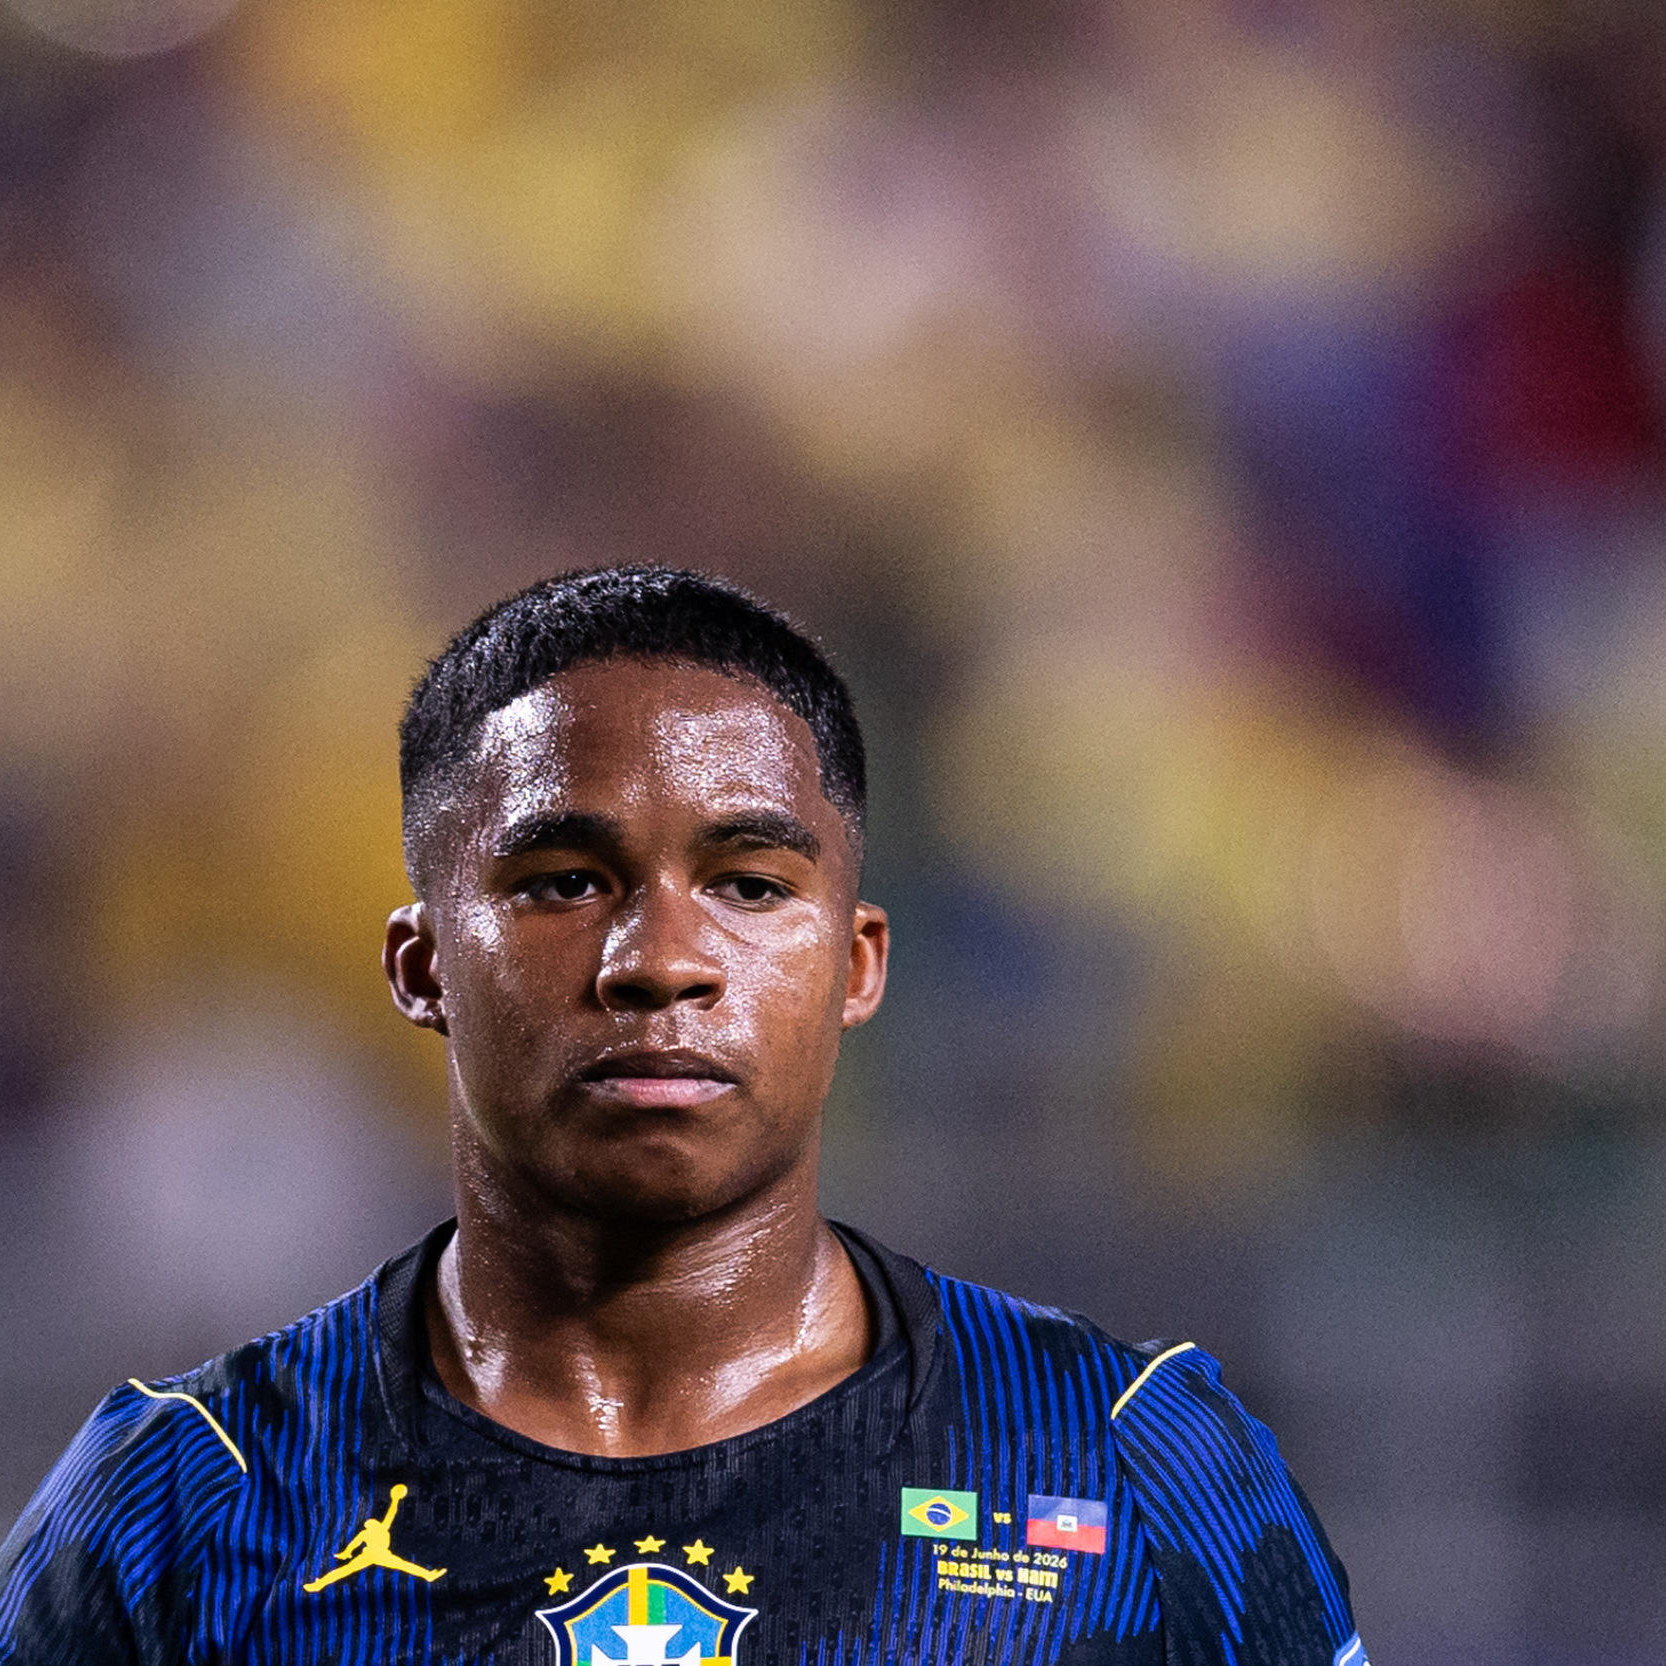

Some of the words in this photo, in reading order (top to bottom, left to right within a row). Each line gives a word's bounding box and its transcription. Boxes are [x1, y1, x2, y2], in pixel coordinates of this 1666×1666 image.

[933, 1544, 948, 1555] 19
[951, 1546, 968, 1558] de
[971, 1547, 1009, 1561] Junho
[1013, 1550, 1030, 1563] de
[1033, 1552, 1068, 1569] 2026
[995, 1569, 1013, 1582] vs
[938, 1578, 1015, 1598] Philadelphia
[1026, 1588, 1053, 1603] EUA
